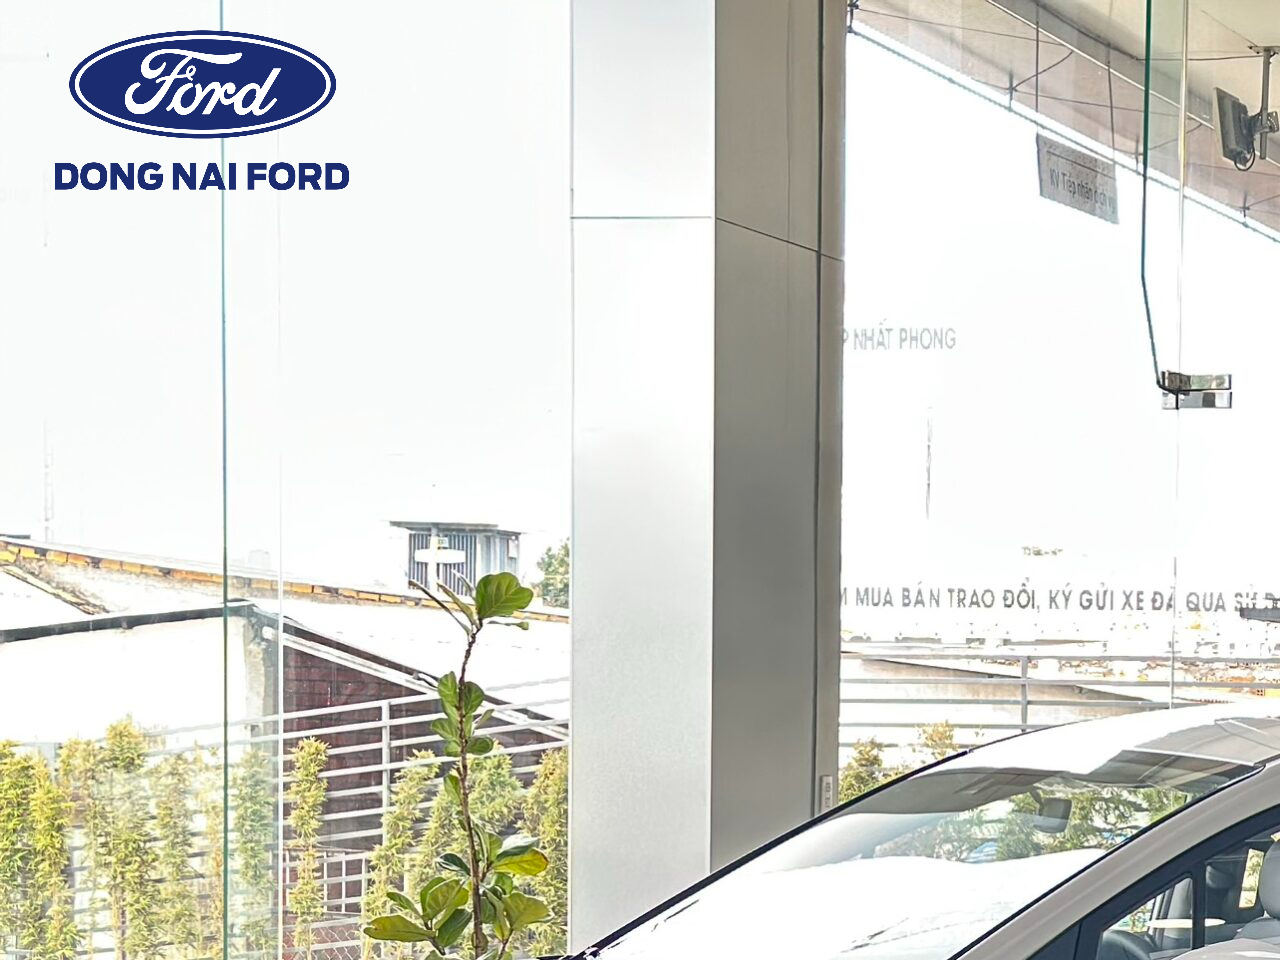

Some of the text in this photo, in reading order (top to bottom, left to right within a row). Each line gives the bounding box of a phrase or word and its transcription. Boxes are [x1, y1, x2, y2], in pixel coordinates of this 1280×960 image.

[854, 318, 893, 350] NHẤT
[899, 327, 956, 350] PHONG
[856, 587, 894, 607] MUA
[902, 581, 940, 608] BÁN
[948, 589, 995, 608] TRAO
[1049, 583, 1072, 609] KÝ
[1080, 583, 1113, 610] GỬI
[1121, 590, 1144, 610] XE
[1186, 592, 1226, 612] QUA
